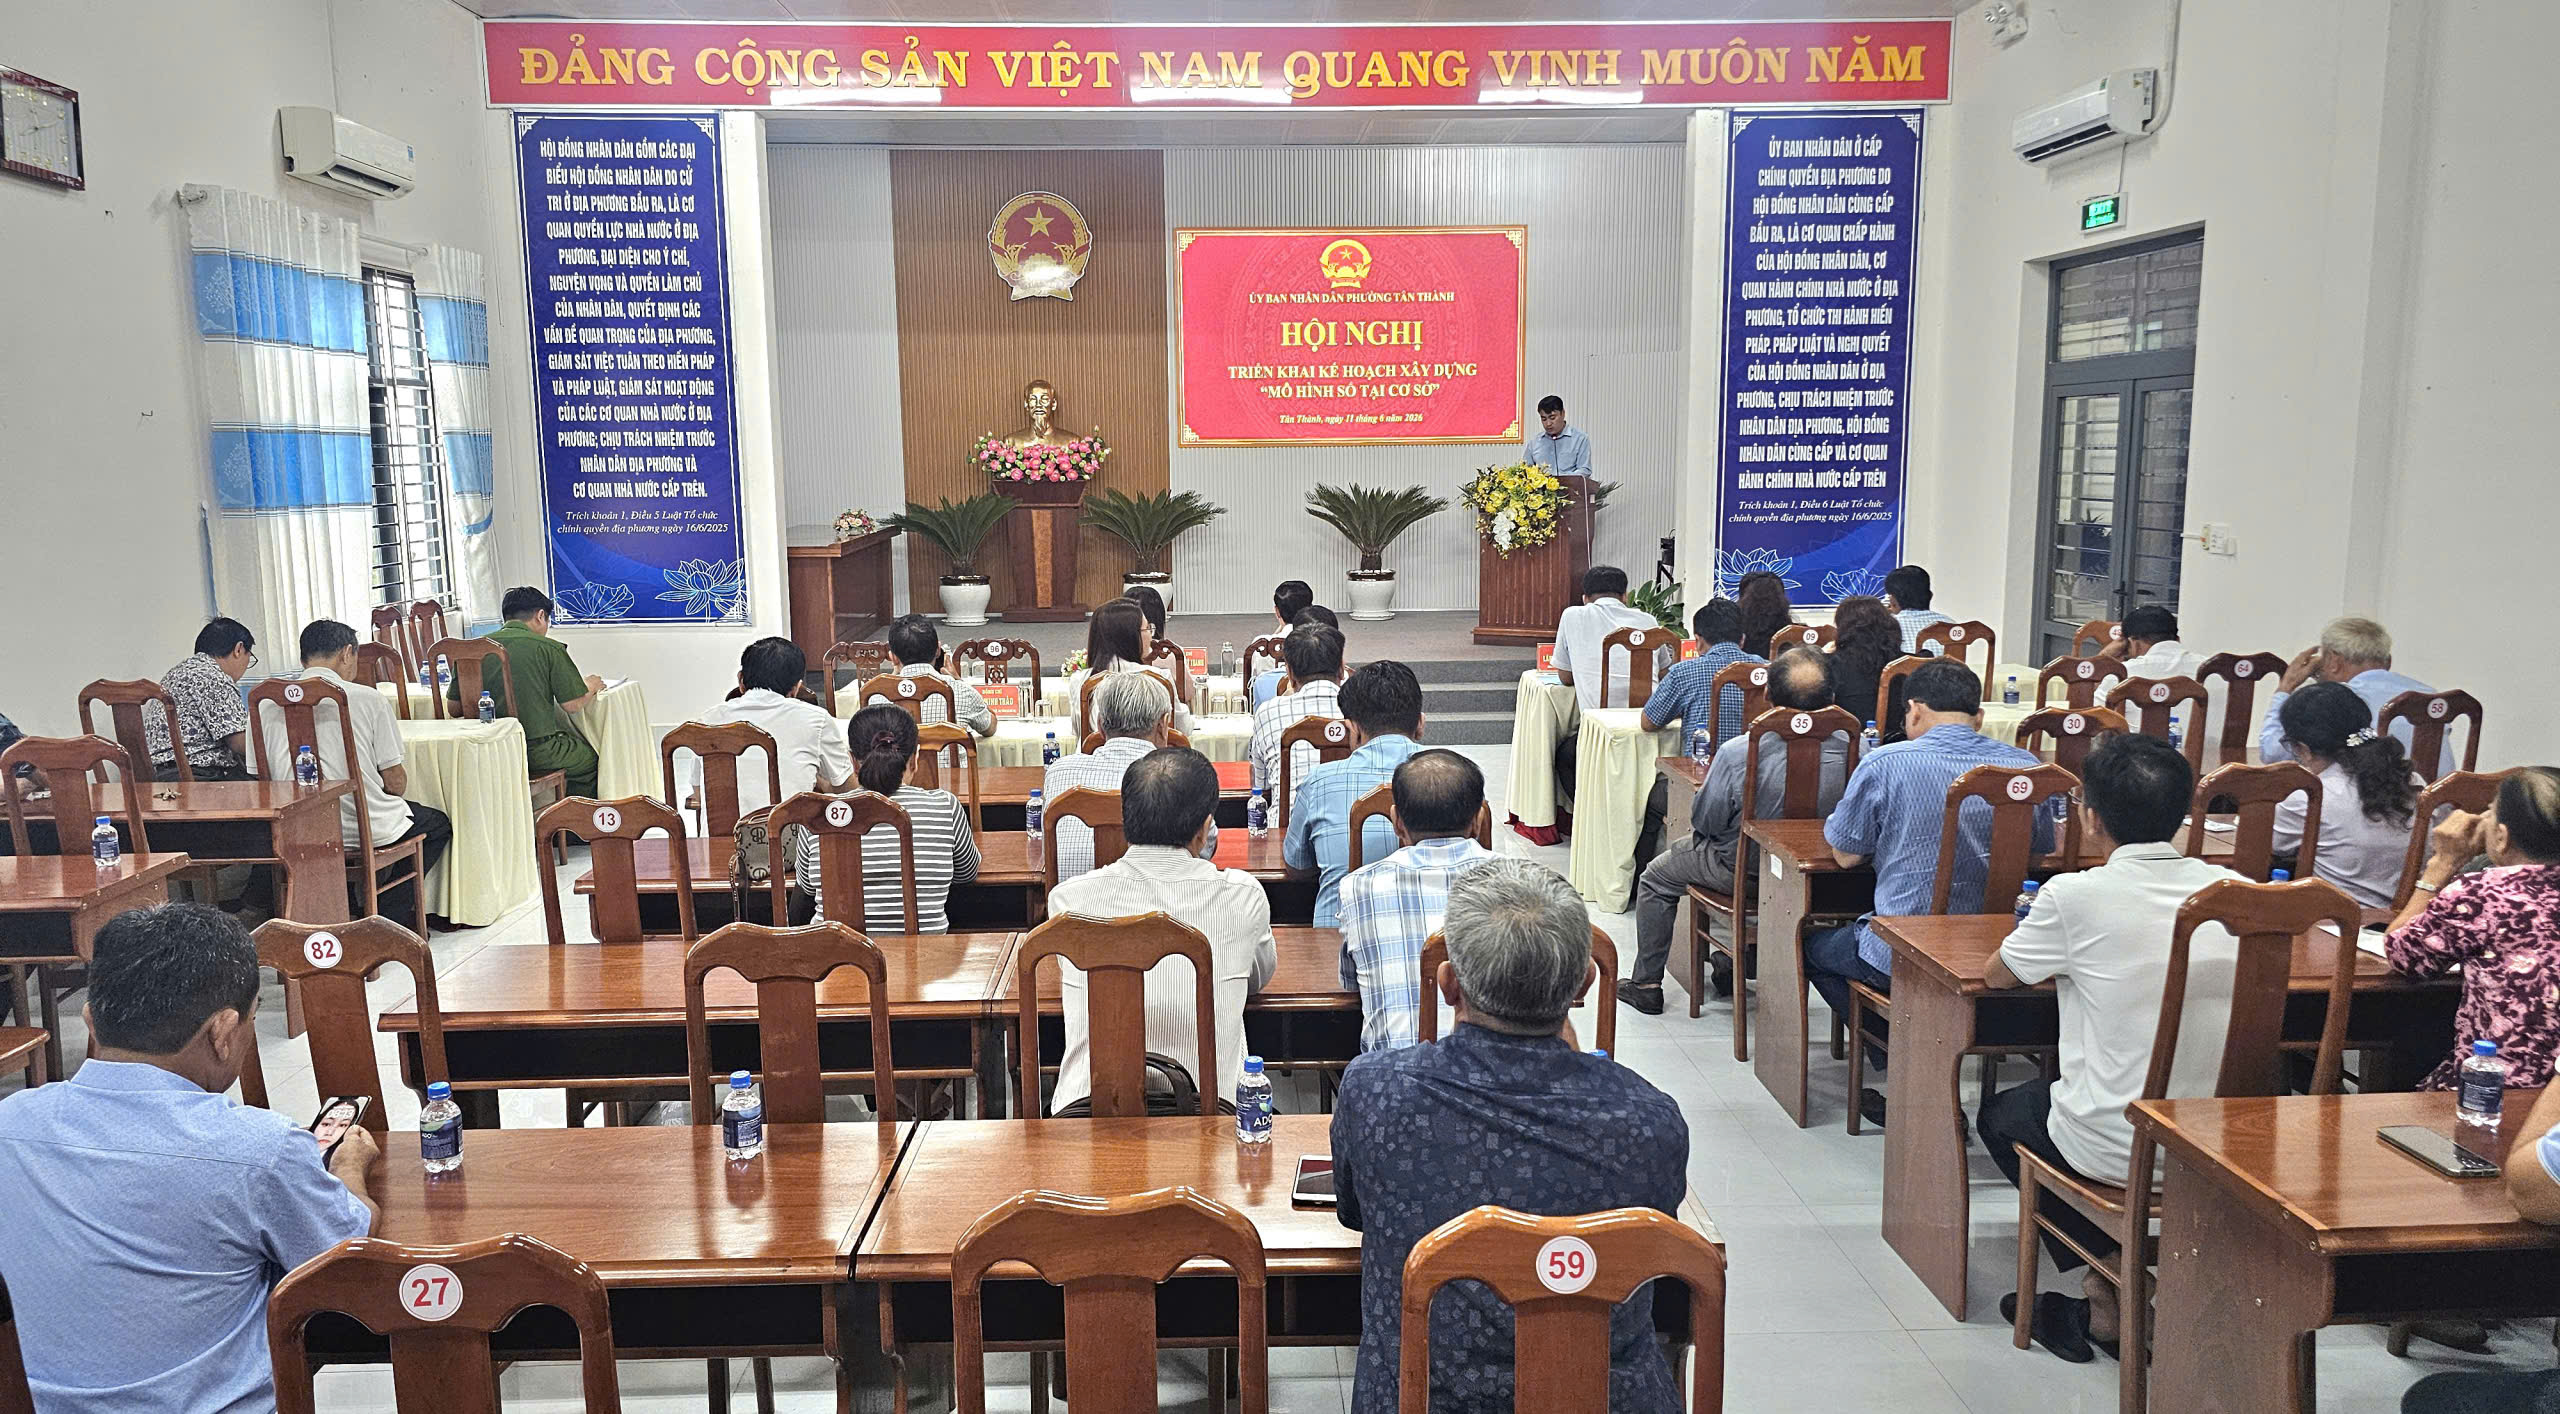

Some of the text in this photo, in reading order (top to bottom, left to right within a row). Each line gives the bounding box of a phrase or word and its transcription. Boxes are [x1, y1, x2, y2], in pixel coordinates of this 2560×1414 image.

[518, 33, 1927, 98] ĐẢNG CỘNG SẢN VIỆT NAM QUANG VINH MUÔN NĂM
[539, 137, 556, 160] HỘI
[585, 138, 612, 158] NHÂN
[613, 138, 634, 158] DÂN
[658, 138, 678, 158] CÁC
[679, 142, 696, 162] ĐẠI
[569, 165, 586, 188] HỘI
[614, 165, 641, 185] NHÂN
[642, 165, 663, 185] DÂN
[664, 169, 678, 185] DO
[679, 164, 692, 186] CỬ
[546, 195, 562, 211] TRI
[563, 189, 571, 211] Ở
[572, 195, 589, 214] ĐỊA
[590, 193, 628, 211] PHƯƠNG
[667, 192, 680, 212] LÀ
[681, 194, 694, 212] CƠ
[600, 248, 617, 268] ĐẠI
[618, 245, 640, 268] DIỆN
[642, 248, 661, 265] CHO
[662, 245, 669, 265] Ý
[1266, 293, 1288, 304] BAN
[1289, 291, 1320, 304] NHÂN
[1321, 291, 1346, 304] DÂN
[1346, 290, 1393, 303] PHƯỜNG
[1393, 290, 1415, 303] TÂN
[1416, 290, 1455, 303] THÀNH
[1280, 317, 1424, 353] HỘI NGHỊ
[1277, 365, 1316, 379] KHAI
[1342, 364, 1396, 380] HOẠCH
[1400, 360, 1431, 377] XÂY
[1434, 361, 1478, 379] DỰNG
[1295, 381, 1334, 398] HÌNH
[1359, 384, 1386, 400] TẠI
[1388, 383, 1411, 397] CƠ
[1325, 415, 1344, 425] ngày
[1355, 413, 1378, 424] tháng
[1385, 413, 1403, 422] năm
[599, 431, 622, 450] CHỊU
[622, 428, 653, 446] TRÁCH
[654, 428, 684, 450] NHIỆM
[685, 428, 715, 446] TRƯỚC
[579, 453, 697, 475] NHÂN DÂN ĐỊA PHƯƠNG VÀ
[572, 481, 586, 498] CƠ
[587, 482, 612, 499] QUAN
[613, 479, 633, 497] NHÀ
[634, 479, 660, 497] NƯỚC
[685, 523, 729, 532] 16/6/2025
[1633, 634, 1642, 642] 71
[1805, 632, 1816, 641] 09
[990, 645, 1000, 653] 96
[1754, 671, 1766, 681] 67
[2080, 665, 2090, 674] 31
[287, 687, 301, 698] 02
[901, 683, 913, 693] 33
[2153, 687, 2166, 697] 40
[2430, 703, 2444, 714] 58
[1794, 718, 1808, 729] 35
[2066, 718, 2081, 730] 30
[1328, 726, 1342, 737] 62
[2012, 781, 2028, 794] 69
[598, 812, 616, 826] 13
[831, 807, 848, 820] 87
[311, 939, 336, 960] 82
[1549, 1250, 1585, 1280] 59
[411, 1277, 450, 1308] 27
